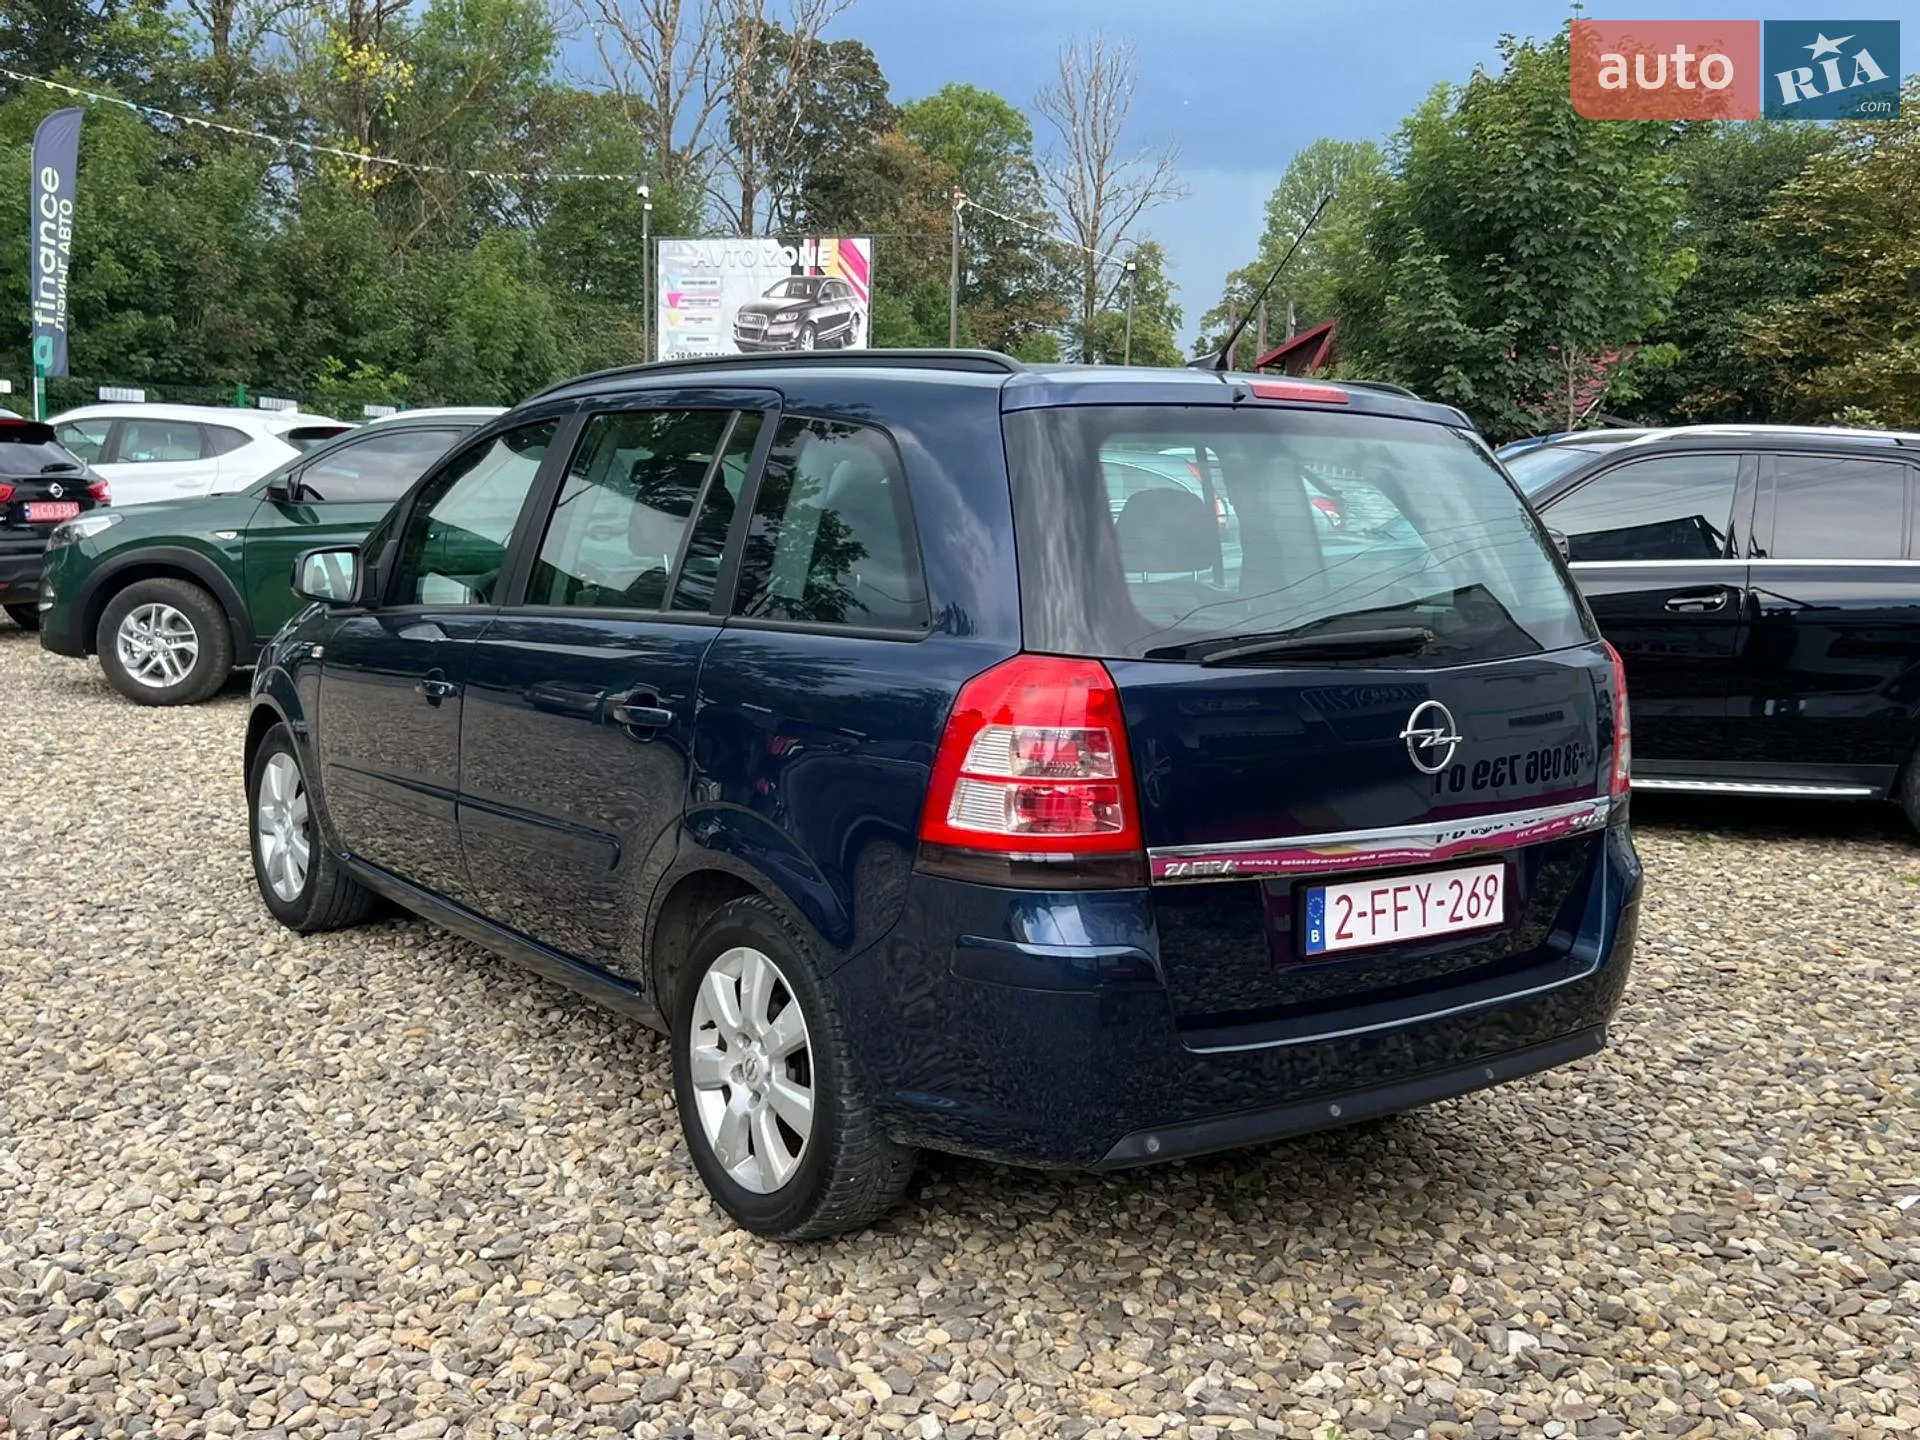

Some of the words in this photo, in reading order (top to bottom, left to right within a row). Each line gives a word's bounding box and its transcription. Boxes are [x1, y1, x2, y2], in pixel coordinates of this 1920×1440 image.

[35, 166, 60, 327] finance
[58, 199, 73, 255] АВТО
[692, 246, 758, 268] AVTO
[760, 246, 833, 268] ZONE
[1165, 860, 1236, 877] ZAFIRA
[1334, 873, 1499, 940] 2-FFY-269
[1311, 930, 1320, 943] B
